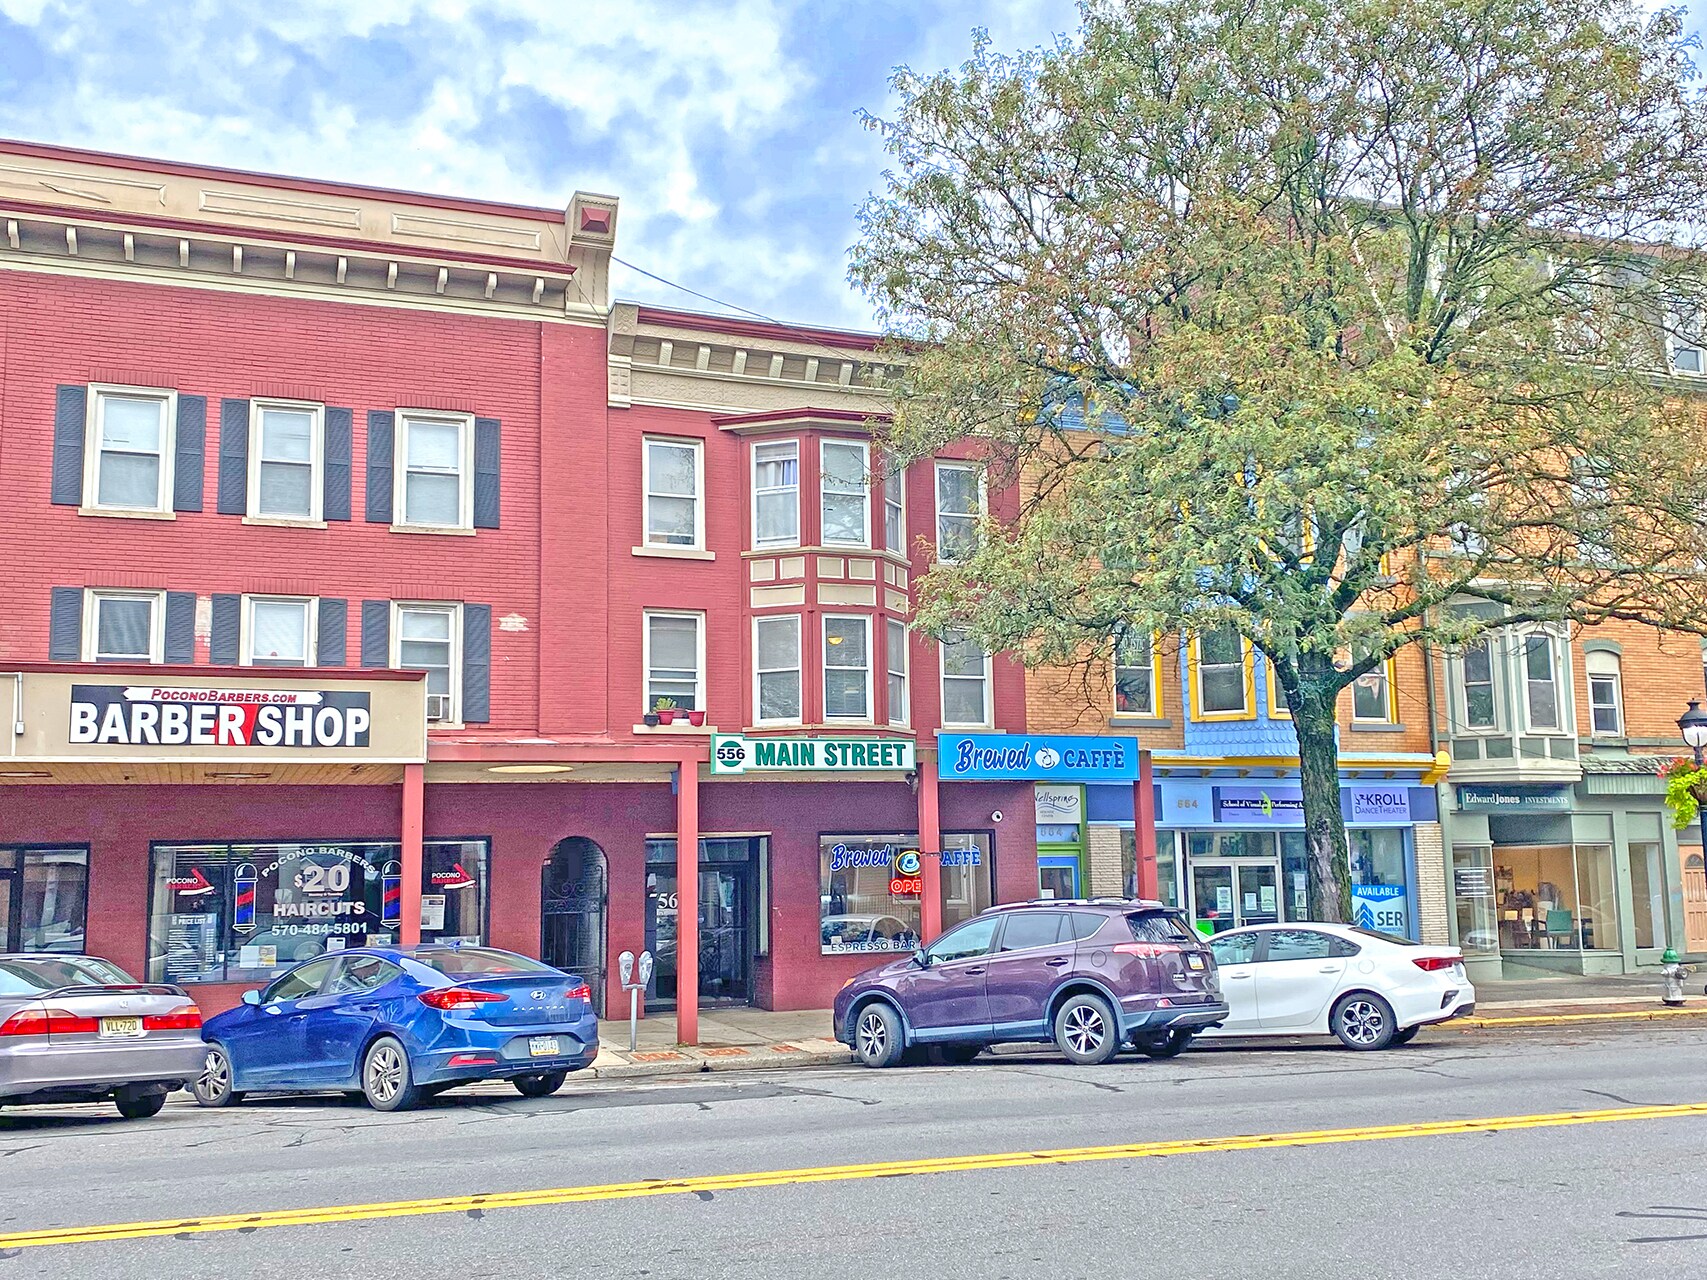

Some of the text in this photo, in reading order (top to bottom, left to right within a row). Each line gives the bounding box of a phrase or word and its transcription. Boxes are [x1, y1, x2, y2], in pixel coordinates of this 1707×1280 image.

[70, 702, 370, 747] BARBER SHOP
[716, 743, 906, 766] 556 MAIN STREET
[954, 739, 1126, 774] Brewed CAFFÈ
[1366, 794, 1406, 806] KROLL
[260, 847, 376, 878] POCONO BARBERS
[831, 843, 981, 871] Brewed AFFÈ
[890, 879, 922, 893] OPE
[1357, 887, 1400, 896] AVAILABLE
[273, 901, 366, 917] HAIRCUTS
[1376, 911, 1404, 927] SER
[272, 922, 368, 936] 570-484-5801
[831, 940, 916, 951] ESPRESSO BAR
